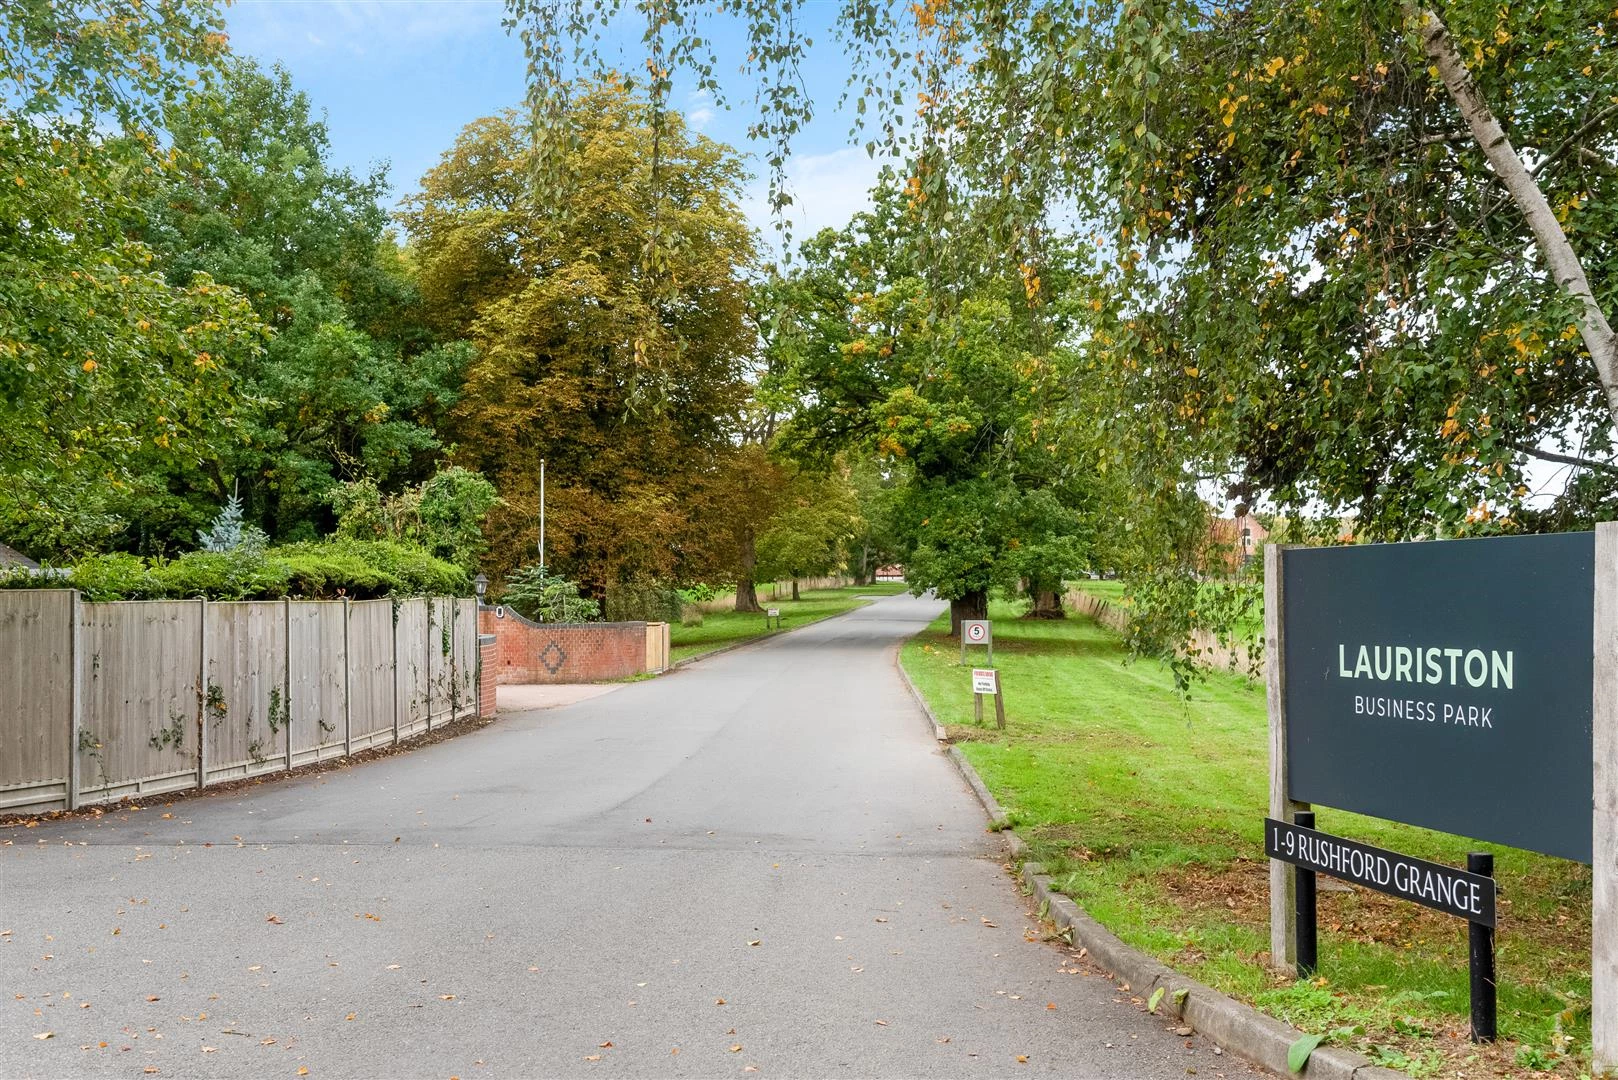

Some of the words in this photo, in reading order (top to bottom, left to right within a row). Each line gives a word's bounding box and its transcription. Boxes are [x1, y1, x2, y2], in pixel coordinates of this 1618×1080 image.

[974, 627, 980, 636] 5
[1339, 643, 1514, 690] LAURISTON
[1354, 695, 1436, 722] BUSINESS
[1443, 703, 1493, 729] PARK
[1273, 827, 1295, 856] 1-9
[1298, 833, 1391, 886] RUSHFORD
[1394, 862, 1482, 915] GRANGE
